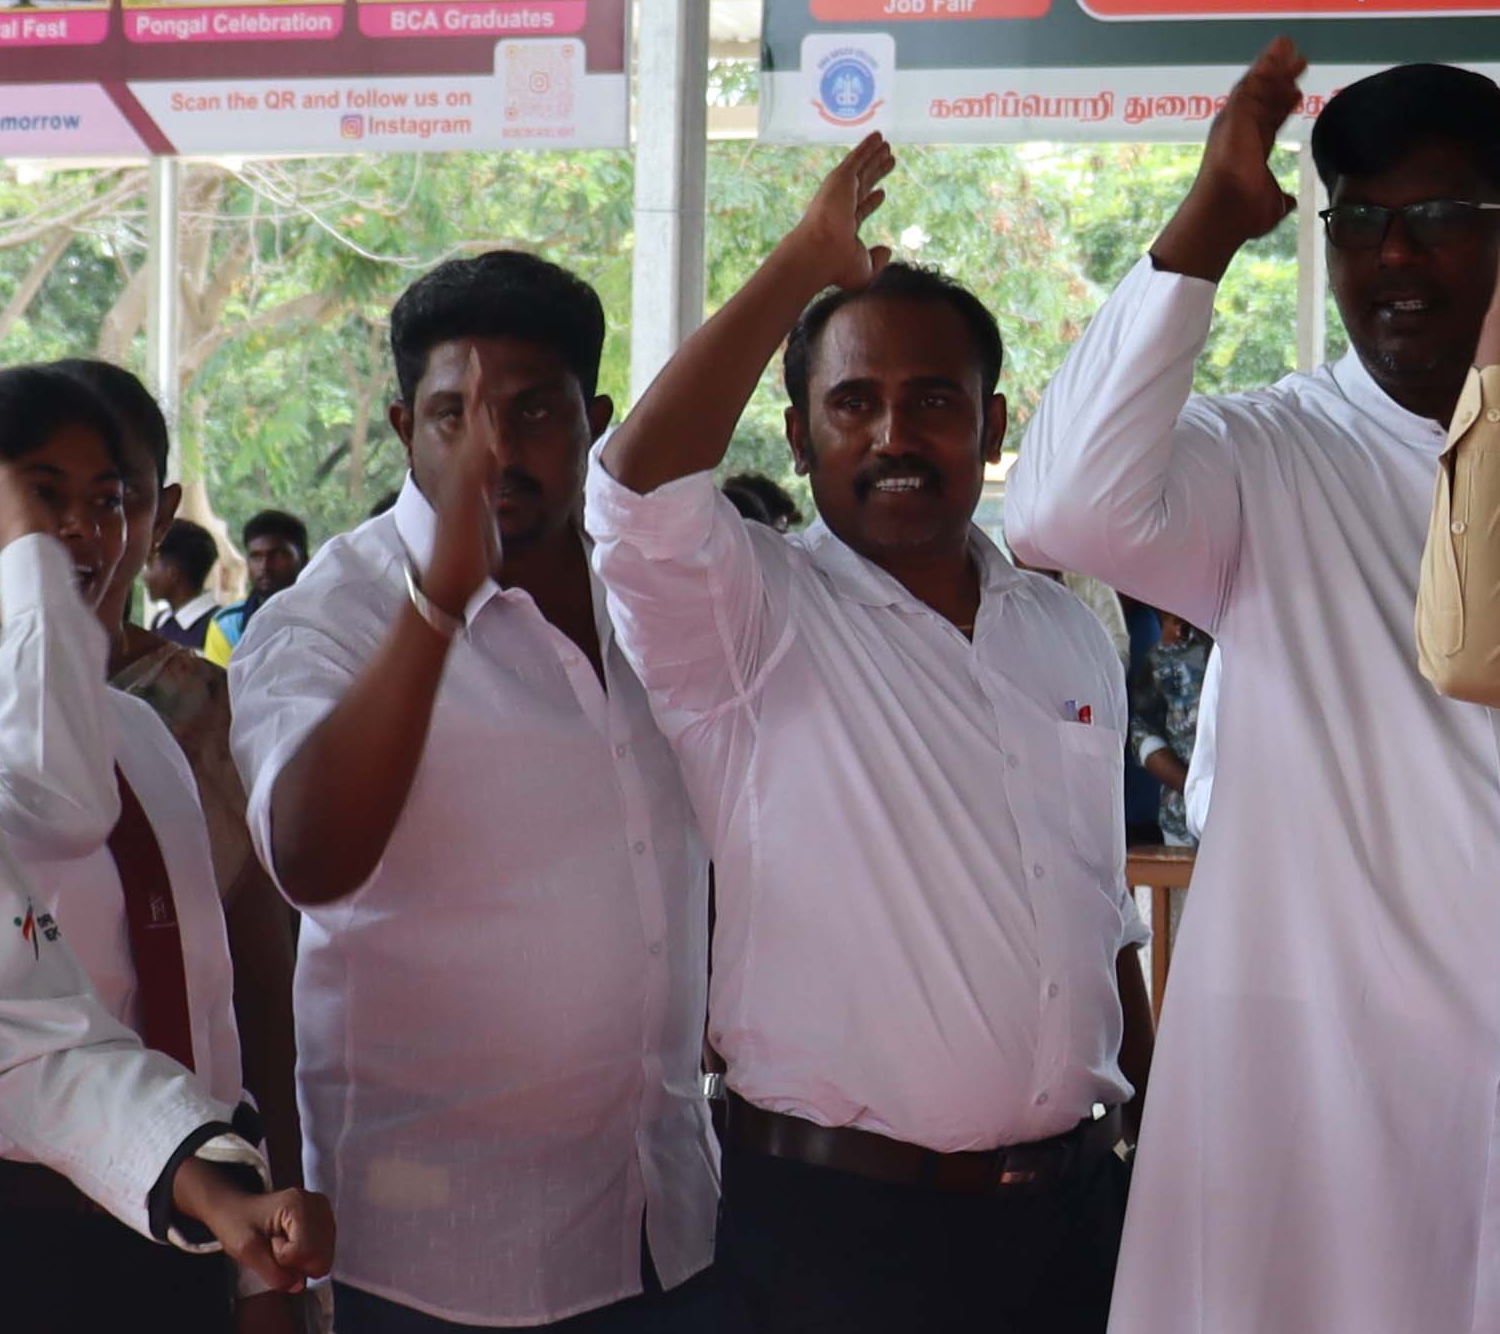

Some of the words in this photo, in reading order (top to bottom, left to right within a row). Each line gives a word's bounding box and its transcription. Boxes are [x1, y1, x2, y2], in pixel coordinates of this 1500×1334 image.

[22, 17, 68, 38] Fest
[136, 15, 207, 39] Pongal
[213, 12, 333, 34] Celebration
[390, 10, 438, 30] BCA
[444, 8, 554, 29] Graduates
[170, 92, 221, 111] Scan
[227, 91, 257, 110] the
[264, 90, 296, 110] QR
[302, 89, 339, 109] and
[346, 88, 408, 108] follow
[415, 92, 438, 107] us
[446, 90, 472, 107] on
[368, 115, 472, 140] Instagram
